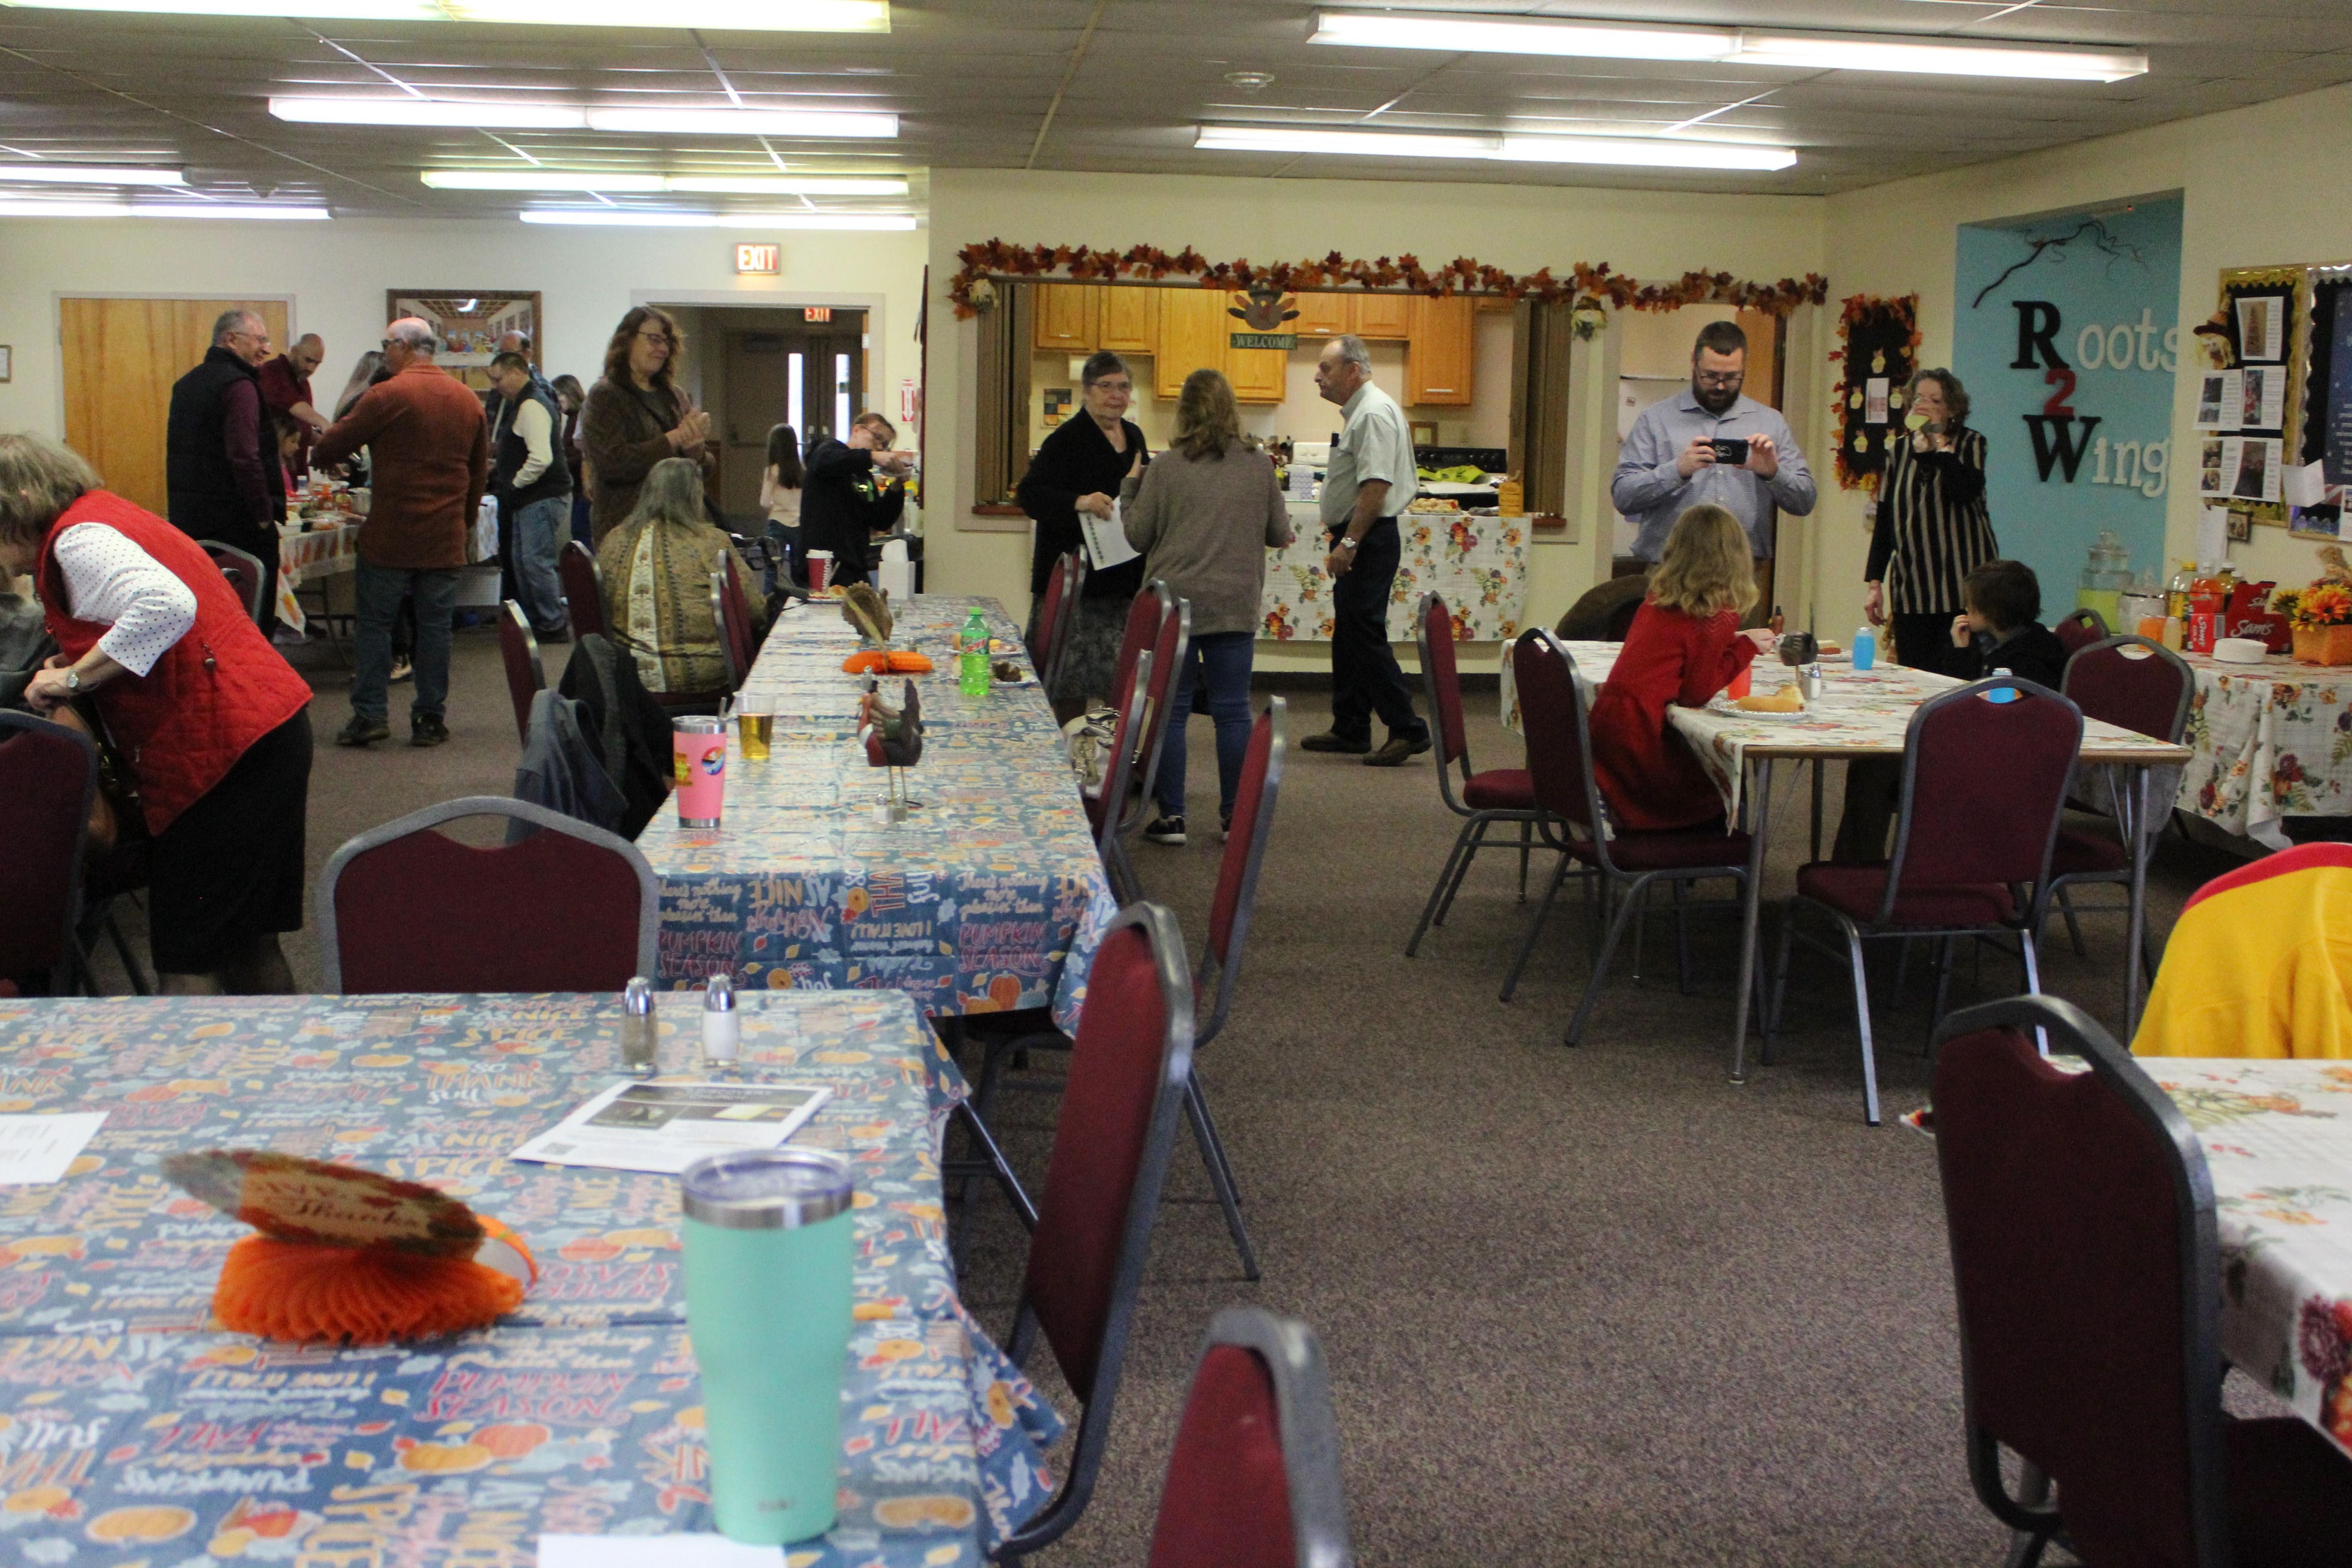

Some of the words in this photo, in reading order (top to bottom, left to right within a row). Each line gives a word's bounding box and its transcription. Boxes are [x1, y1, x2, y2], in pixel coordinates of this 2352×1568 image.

[738, 245, 777, 270] EXIT
[1236, 334, 1294, 349] WELCOME
[2044, 369, 2077, 415] 2
[2230, 619, 2275, 638] Sam's
[747, 879, 804, 909] NICE
[658, 930, 744, 953] PUMPKIN
[959, 922, 1049, 948] PUMPKIN
[658, 951, 743, 978] SEASON
[958, 946, 1046, 975] SEASON
[426, 1072, 541, 1090] THANK
[385, 1157, 516, 1177] SPICE
